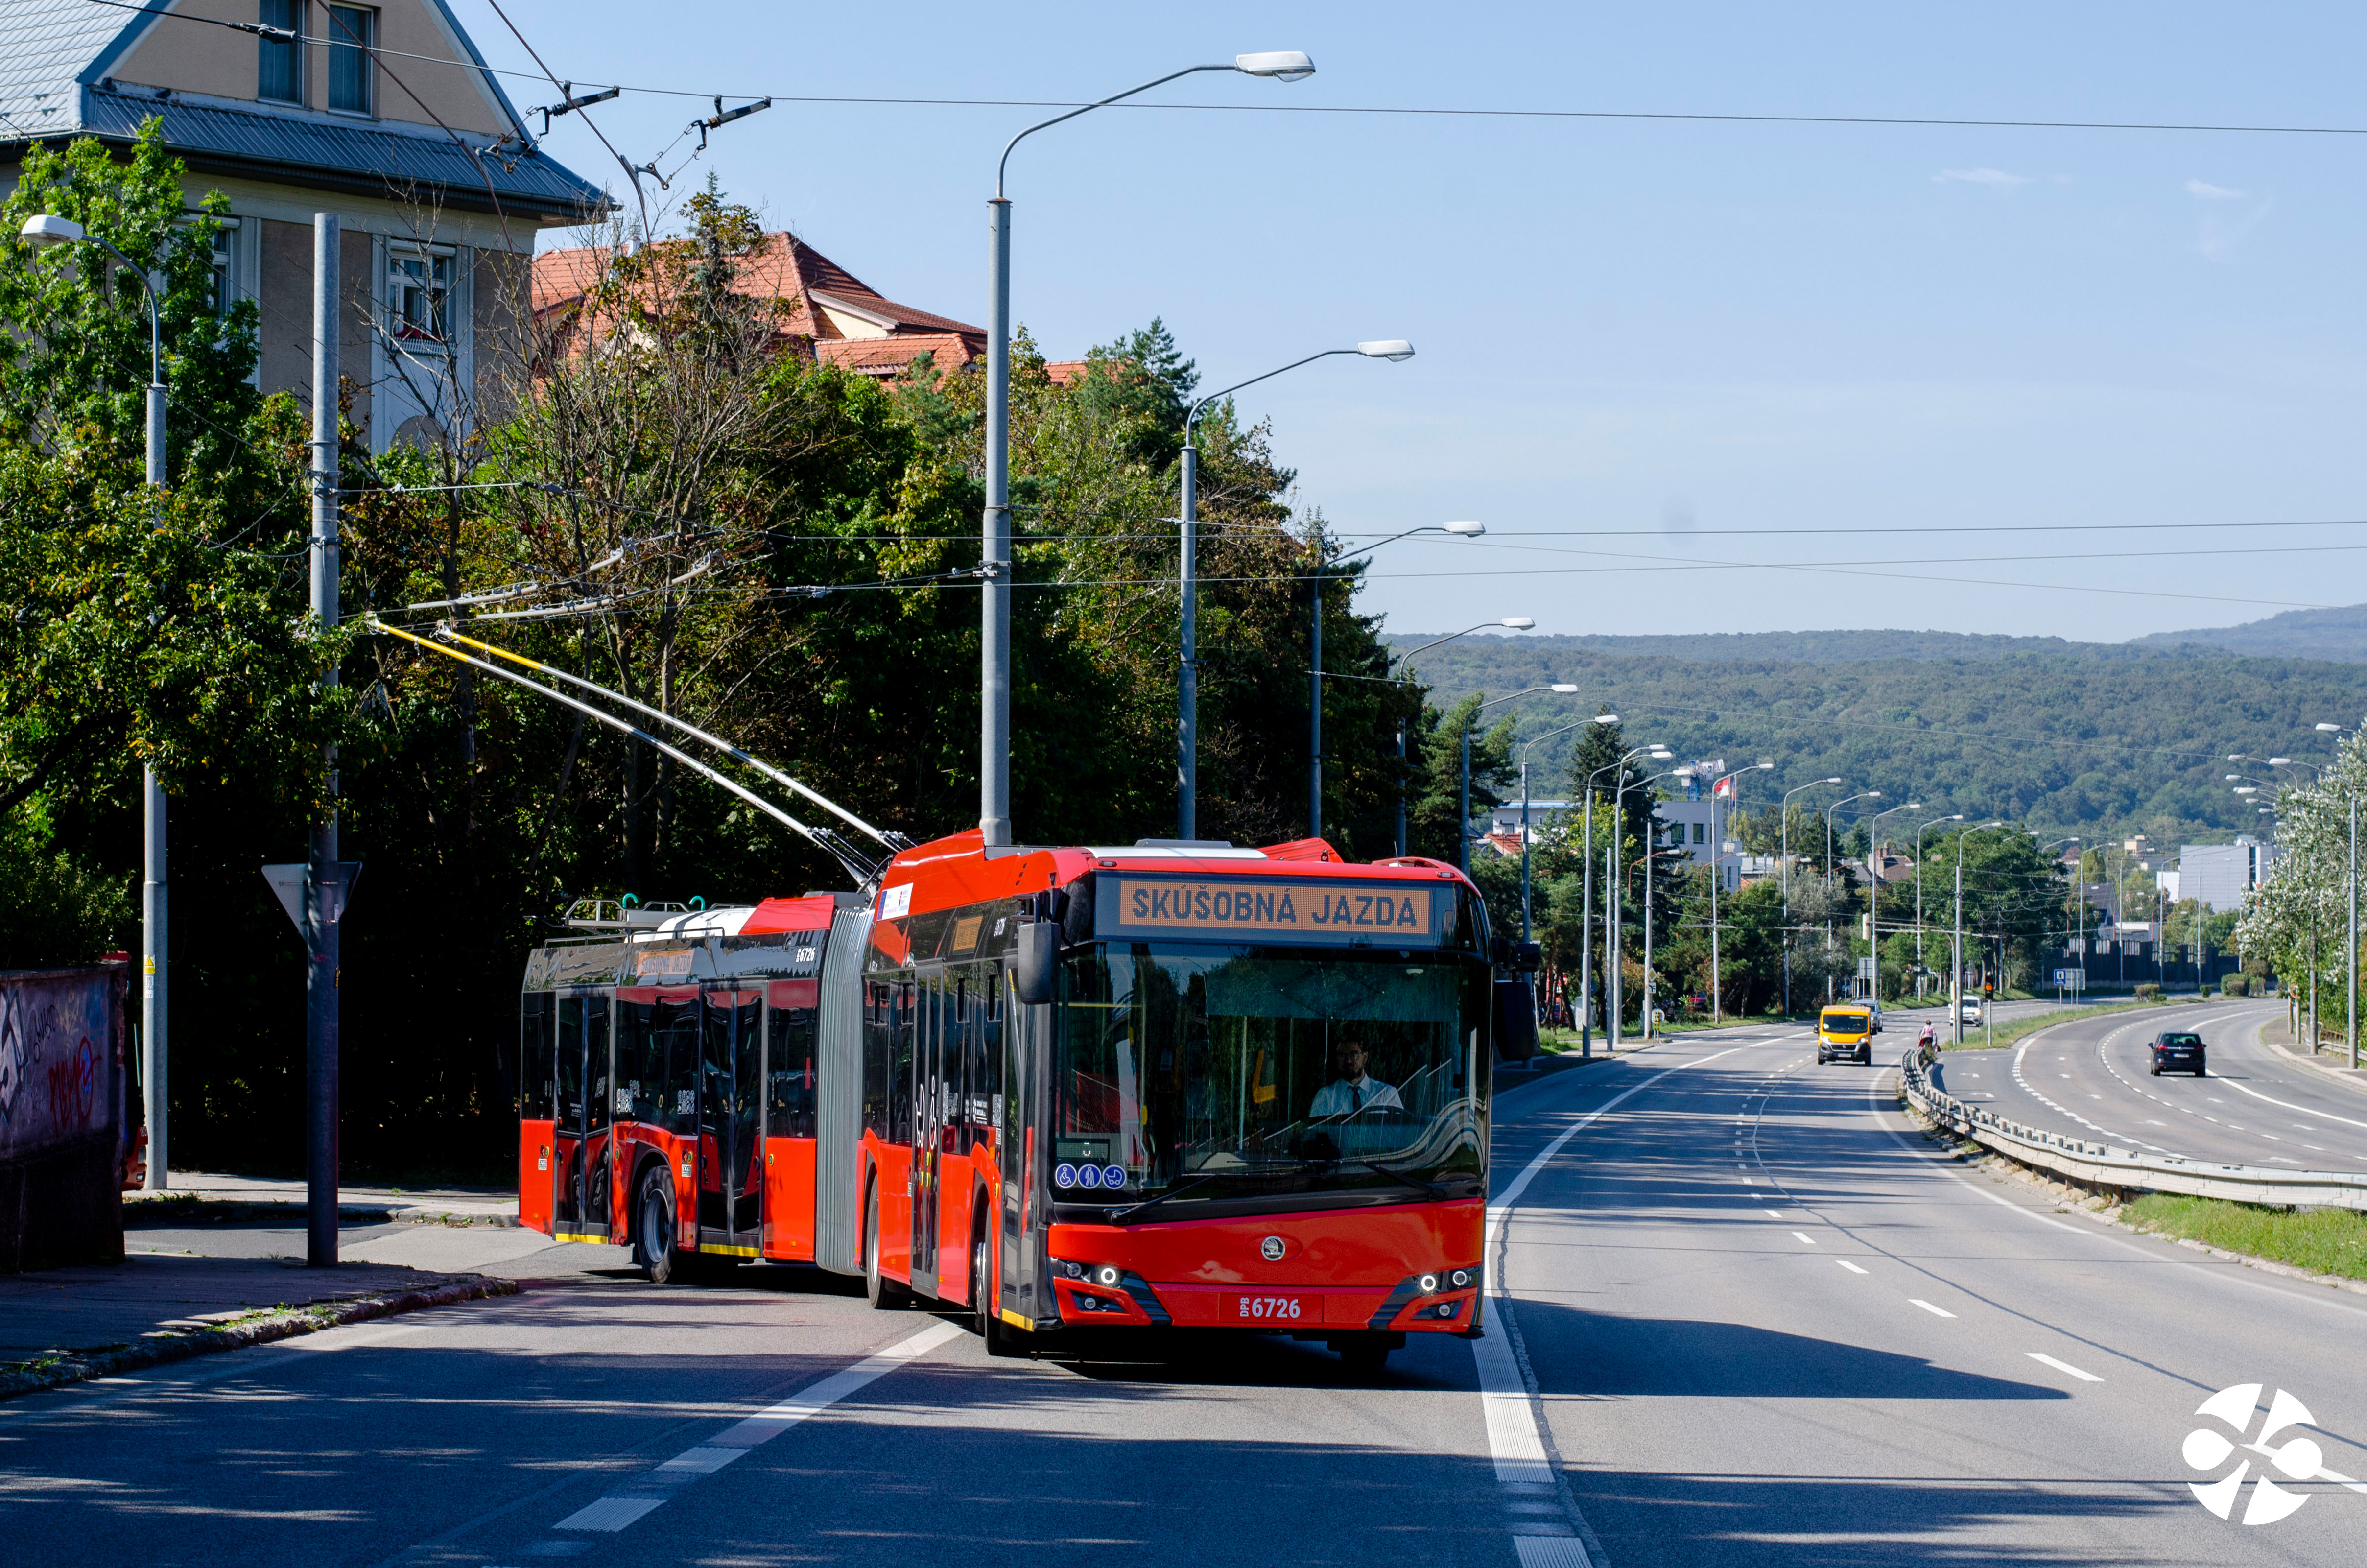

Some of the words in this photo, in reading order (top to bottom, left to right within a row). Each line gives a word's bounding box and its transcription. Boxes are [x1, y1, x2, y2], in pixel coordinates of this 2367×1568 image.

[1133, 884, 1297, 923] SKÚŠOBNÁ
[1311, 894, 1418, 927] JAZDA
[672, 954, 691, 972] JAZDA
[800, 947, 816, 962] 6726
[1240, 1297, 1249, 1317] DPB
[1252, 1298, 1301, 1318] 6726
